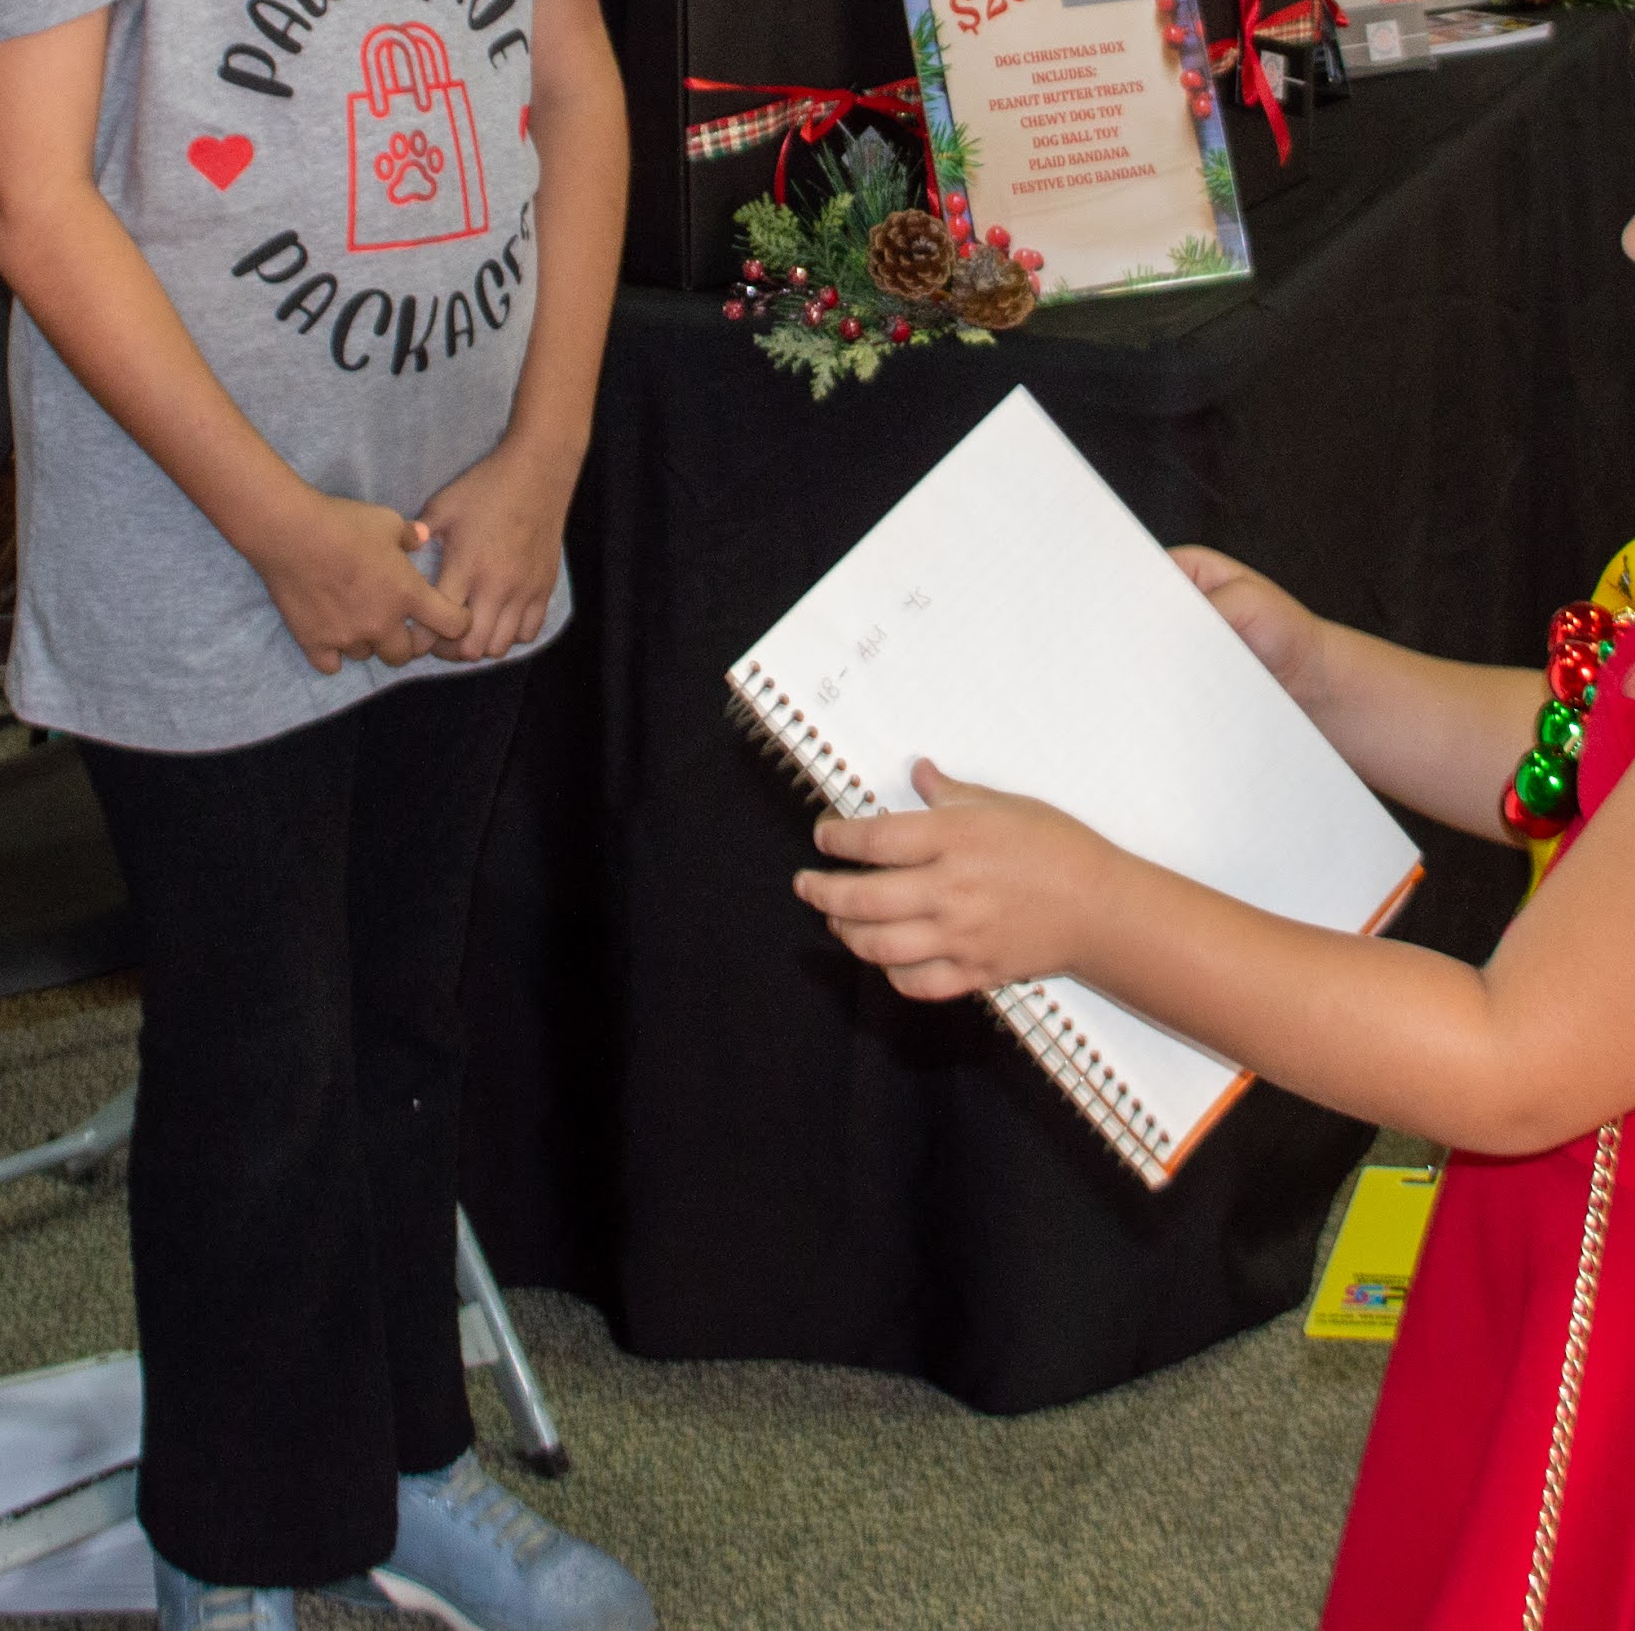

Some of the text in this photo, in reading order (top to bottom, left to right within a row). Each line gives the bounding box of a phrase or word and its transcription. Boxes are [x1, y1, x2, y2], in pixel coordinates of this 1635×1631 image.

[994, 40, 1126, 68] DOG CHRISTMAS BOX
[989, 80, 1145, 112] PEANUT BUTTER TREATS
[1020, 104, 1124, 129] CHEWY DOG TOY
[1032, 126, 1119, 150] DOG BALL TOY
[1029, 146, 1130, 171] PLAID BANDANA
[1011, 163, 1157, 195] FESTIVE DOG BANDANA
